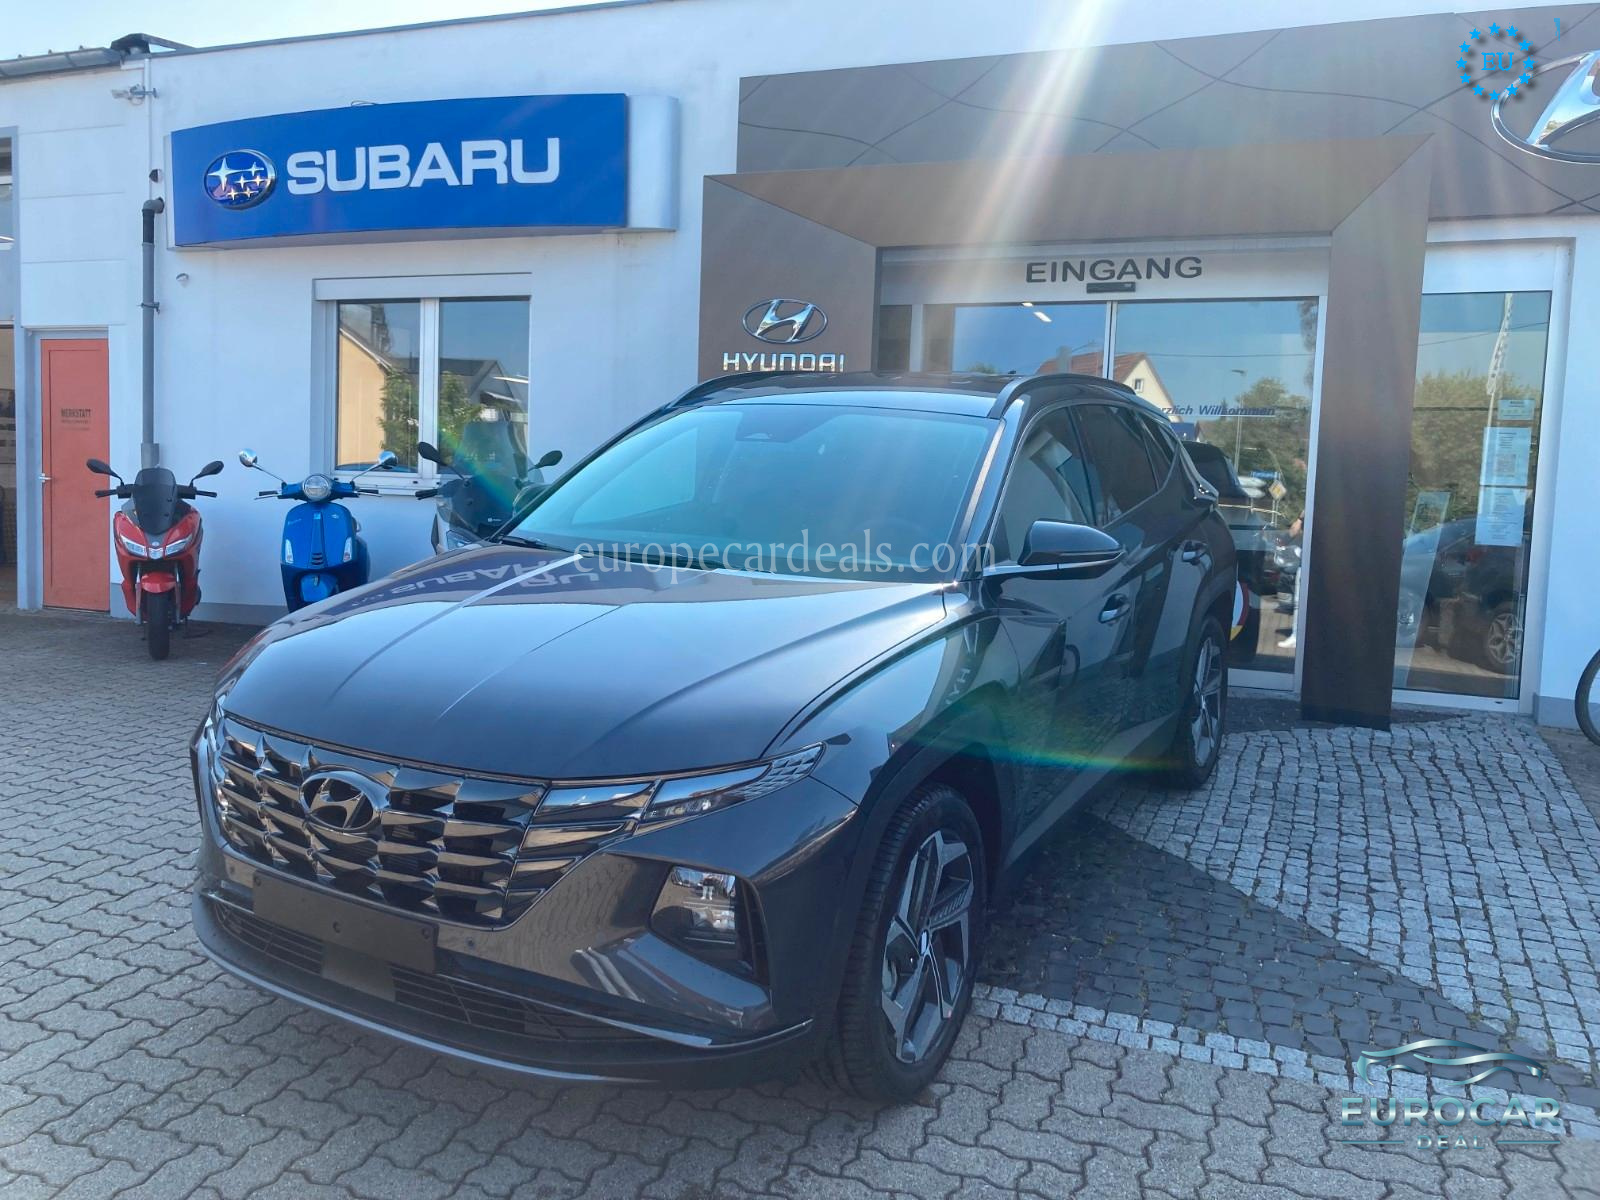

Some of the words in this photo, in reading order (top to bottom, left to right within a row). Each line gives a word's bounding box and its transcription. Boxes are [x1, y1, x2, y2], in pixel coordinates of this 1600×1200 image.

[286, 137, 560, 195] SUBARU
[1026, 256, 1203, 283] EINGANG
[723, 352, 845, 372] HYUNDAI
[1161, 404, 1194, 416] rzlich
[1199, 404, 1276, 416] Willkommen
